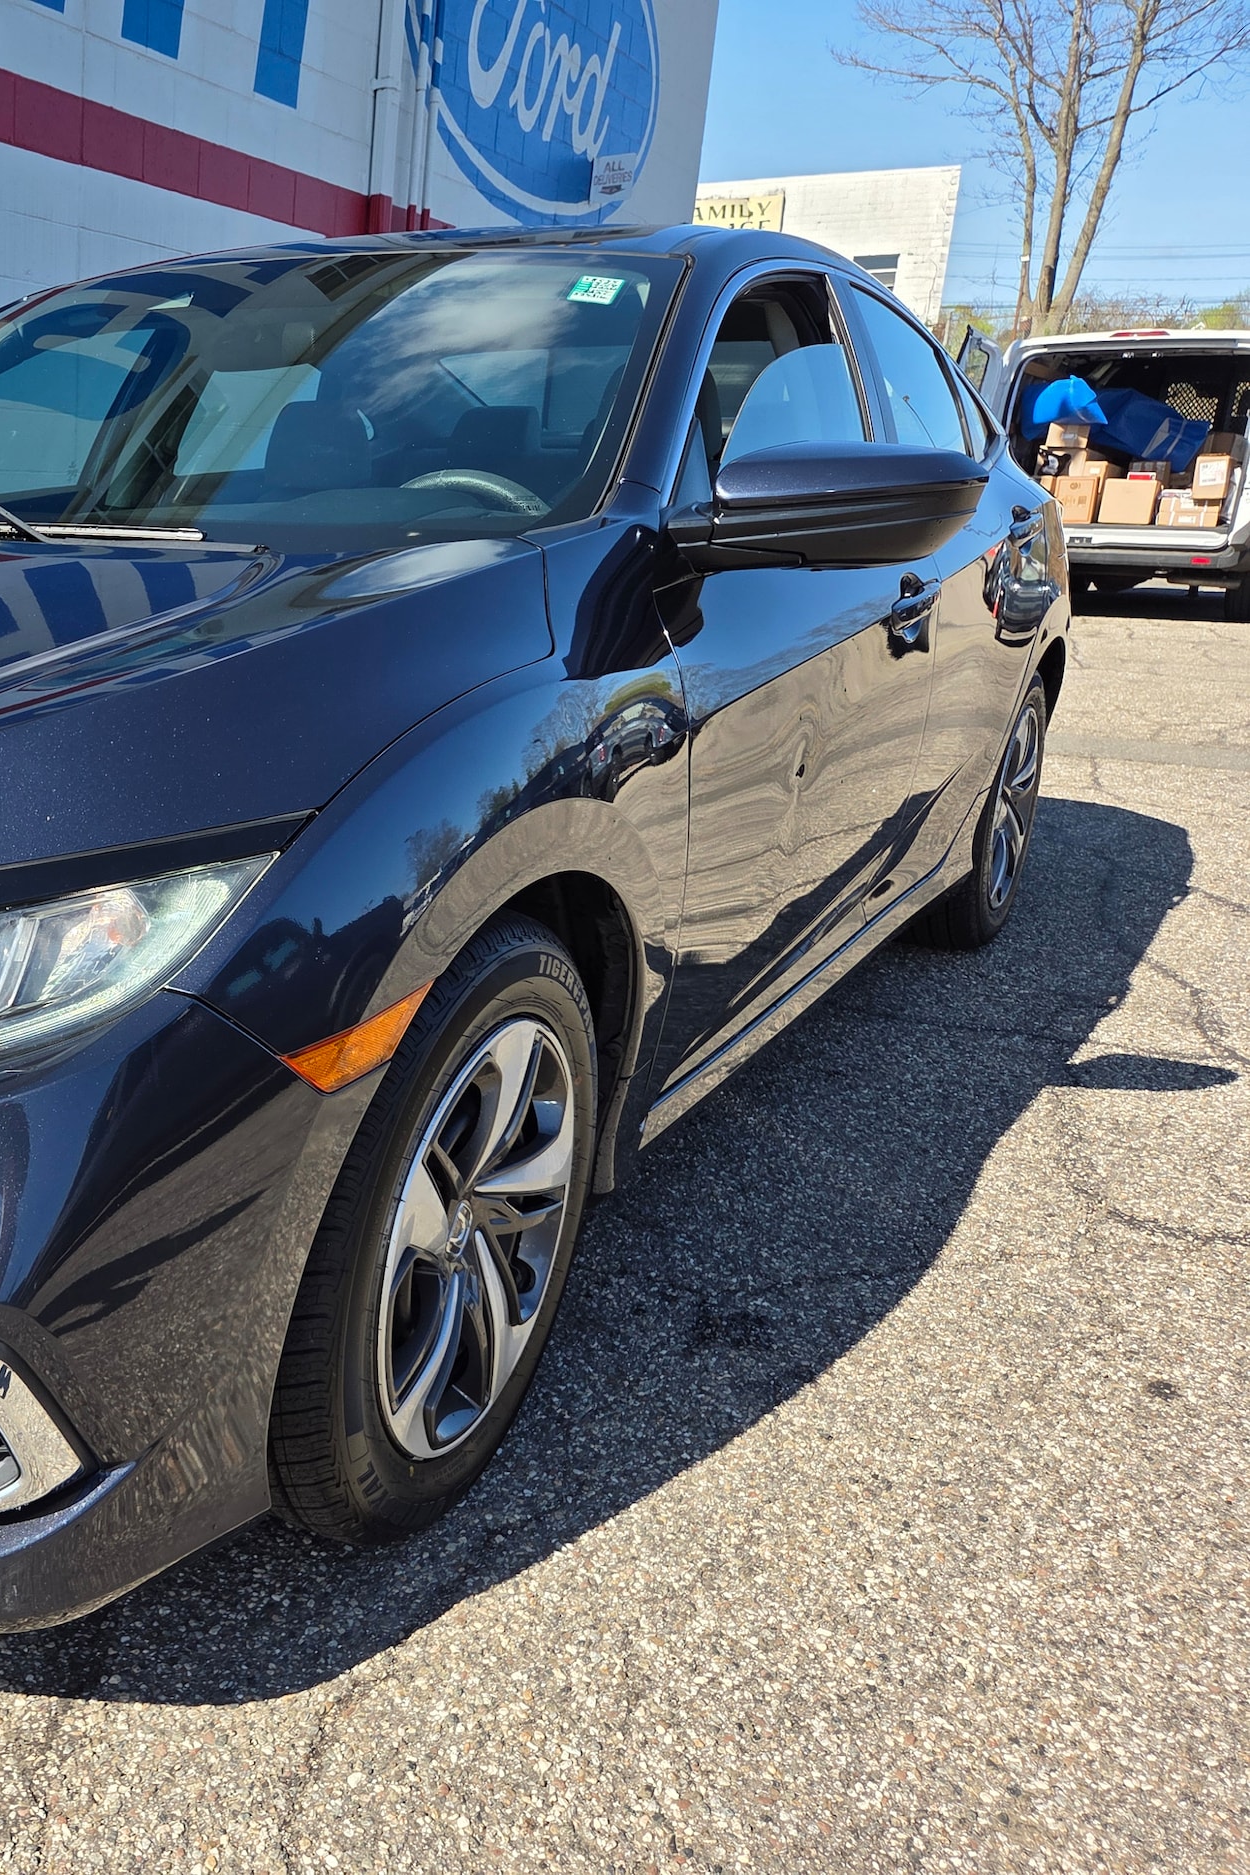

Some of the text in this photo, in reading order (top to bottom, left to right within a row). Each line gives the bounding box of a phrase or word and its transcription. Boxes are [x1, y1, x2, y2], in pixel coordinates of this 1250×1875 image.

[603, 160, 625, 174] ALL
[593, 170, 633, 186] DELIVERIES
[538, 954, 575, 991] TIGER
